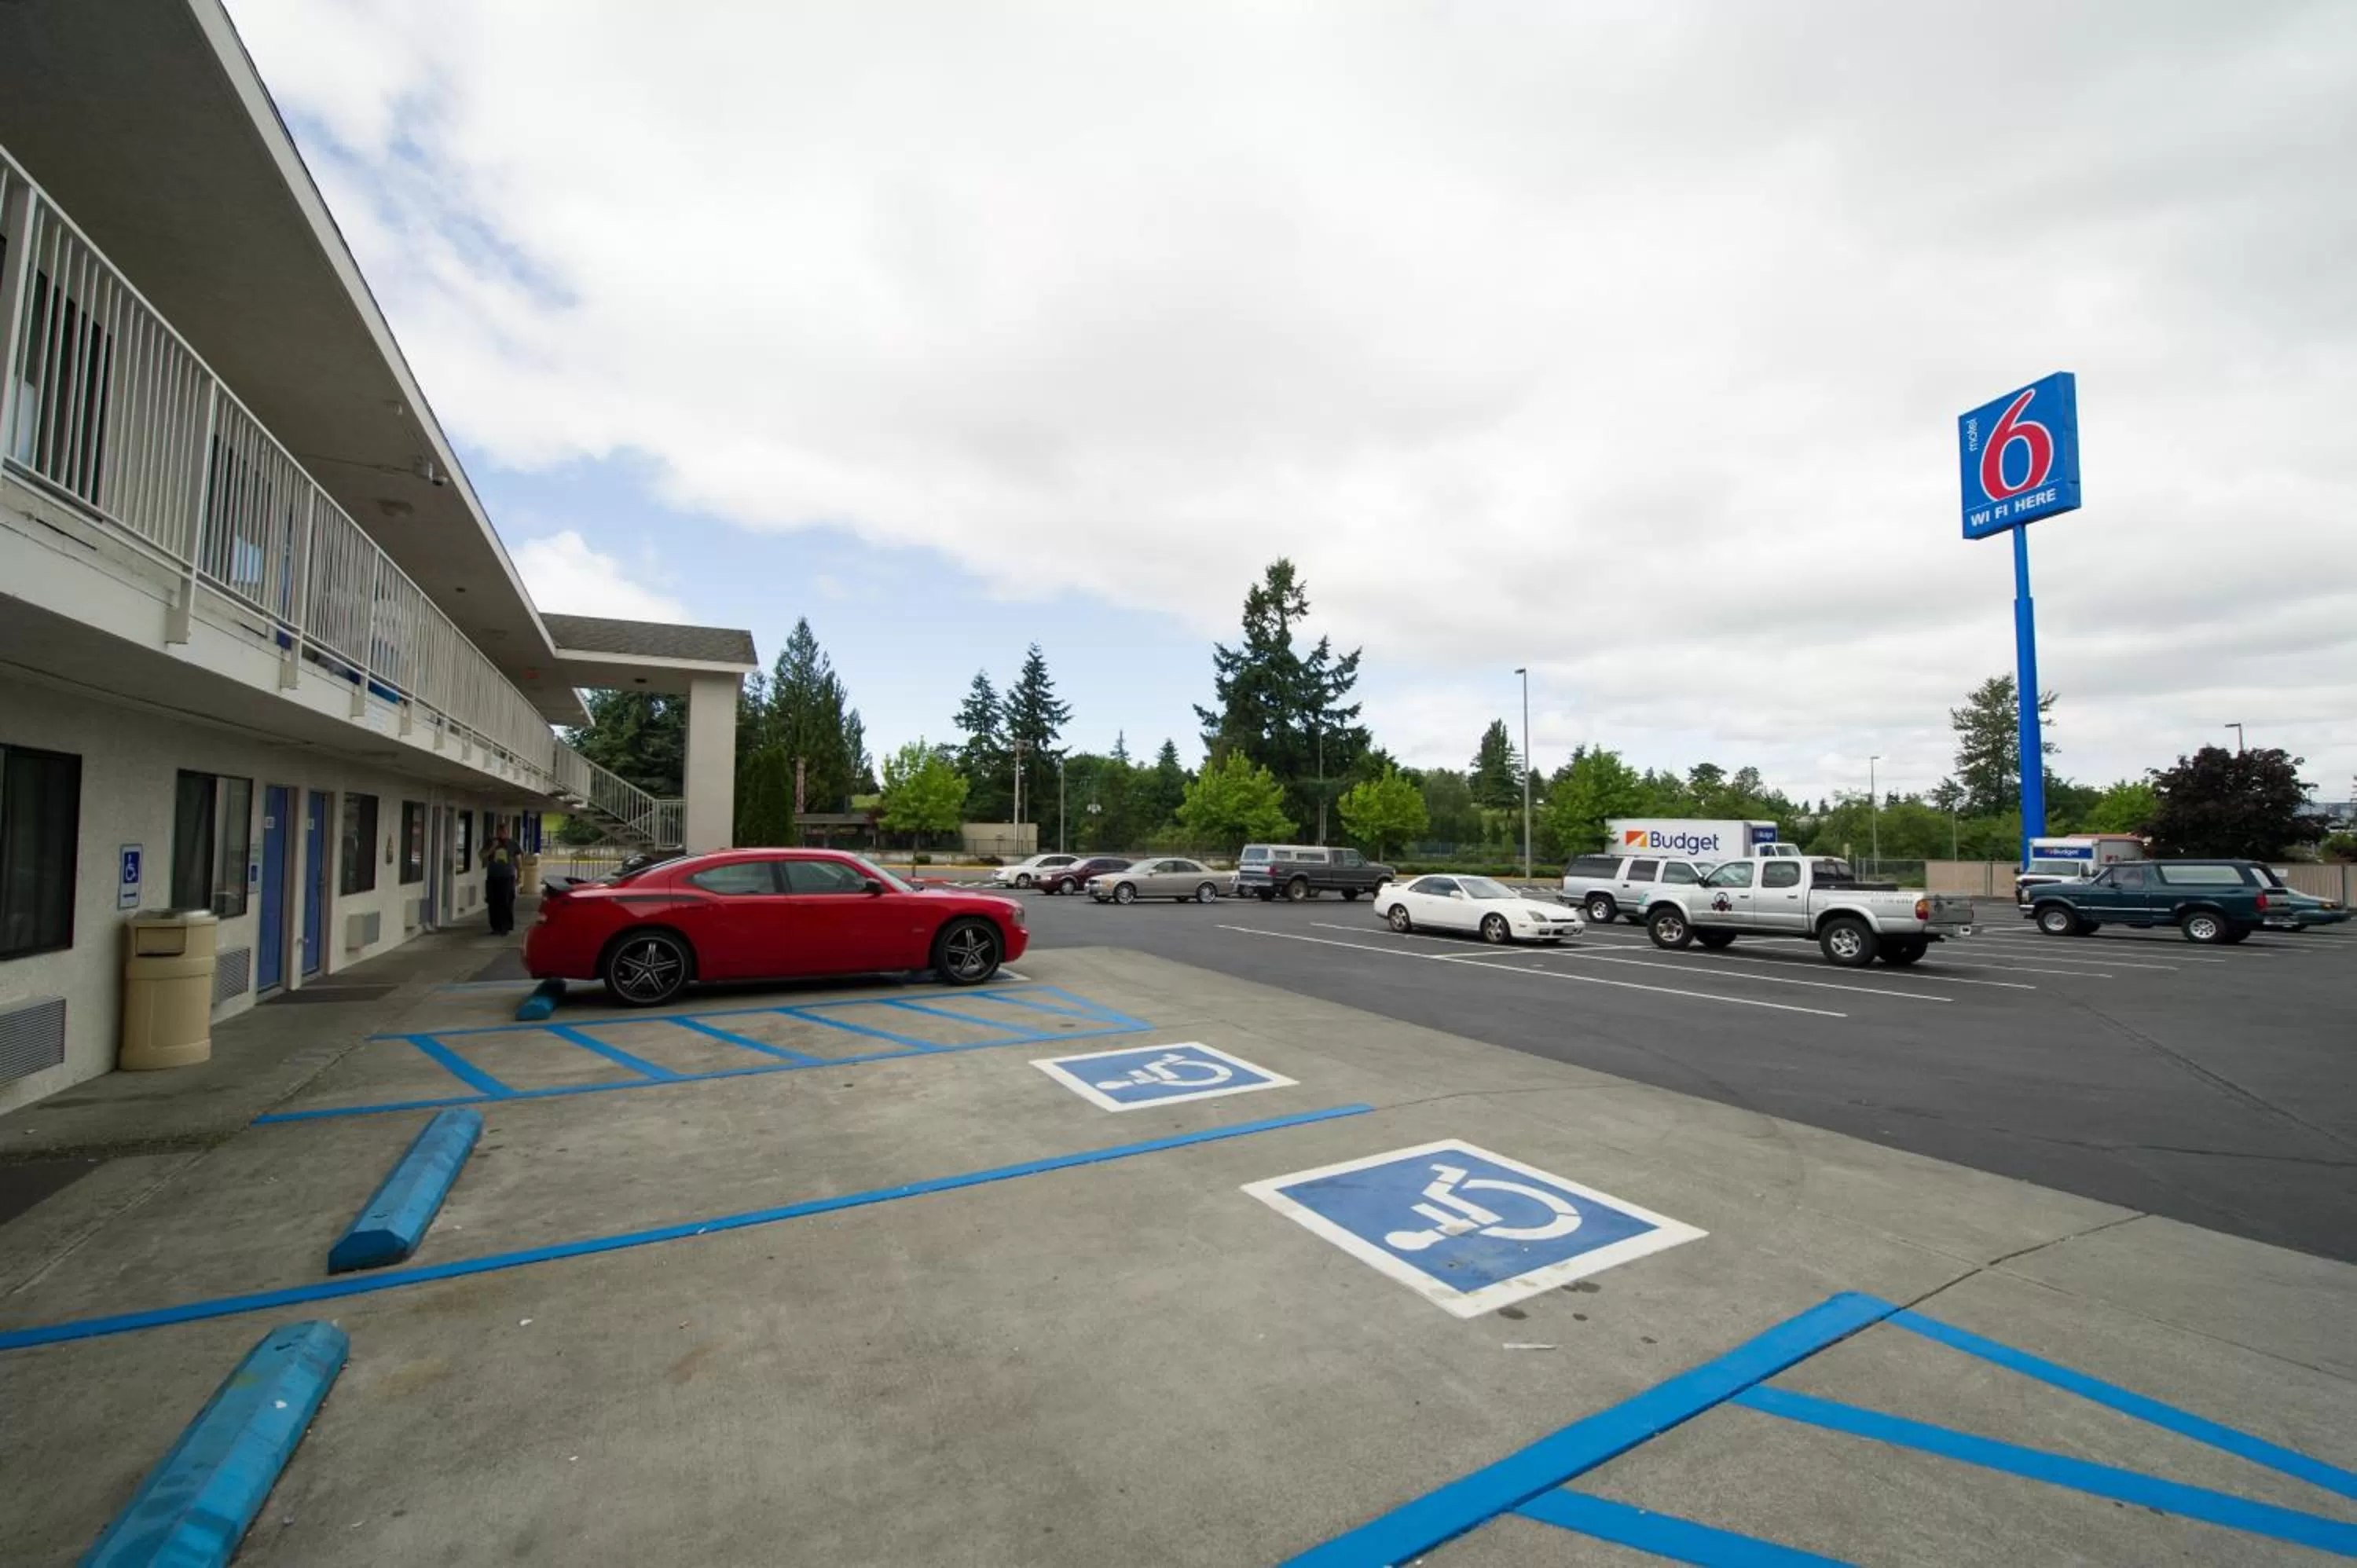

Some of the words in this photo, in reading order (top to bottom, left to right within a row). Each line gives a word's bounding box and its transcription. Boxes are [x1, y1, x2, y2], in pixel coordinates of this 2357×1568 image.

[1979, 387, 2054, 502] 6
[1970, 510, 1990, 527] WI
[1995, 504, 2008, 519] FI
[2014, 488, 2057, 513] HERE
[1651, 831, 1720, 855] Budget
